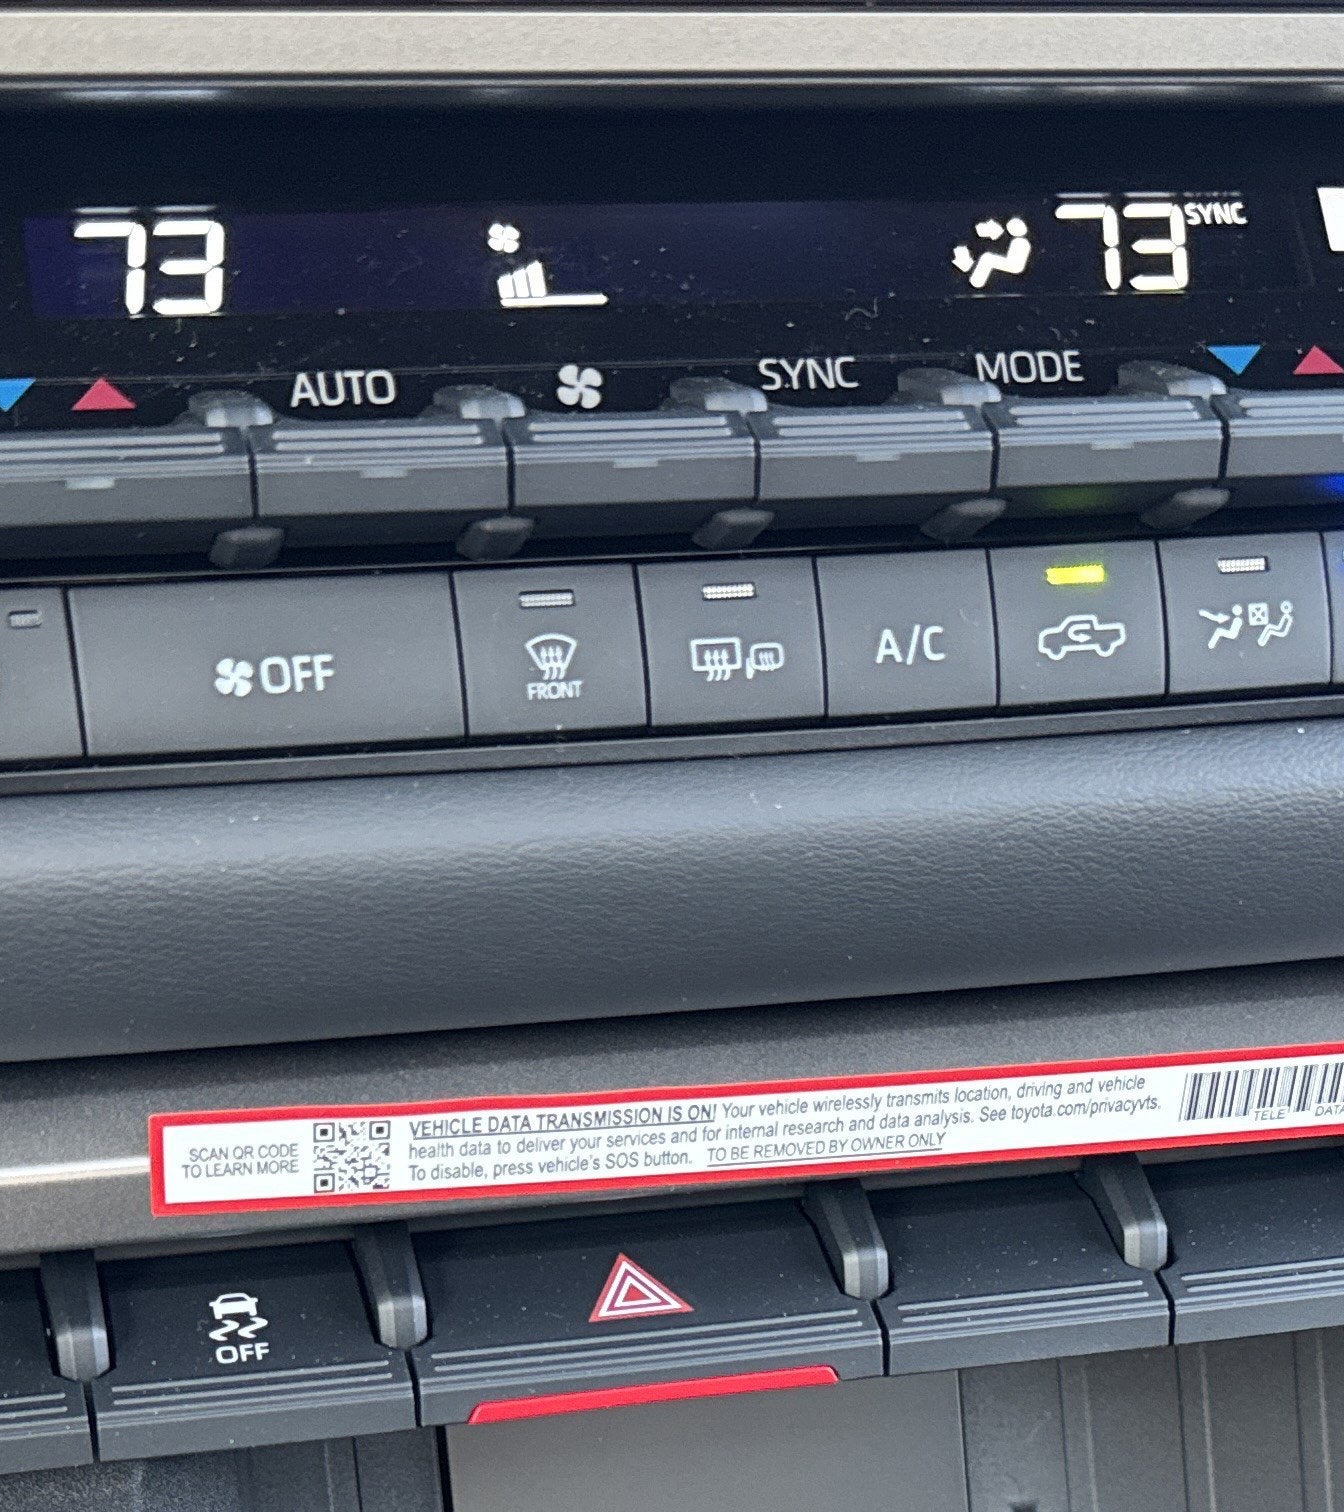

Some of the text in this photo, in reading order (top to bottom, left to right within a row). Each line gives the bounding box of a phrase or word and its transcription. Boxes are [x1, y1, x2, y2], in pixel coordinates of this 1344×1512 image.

[1056, 202, 1248, 292] 73 SYNC
[73, 220, 225, 316] 73
[758, 357, 859, 391] SYNC
[975, 352, 1085, 385] MODE
[290, 370, 397, 408] AUTO
[875, 625, 946, 665] A/C
[259, 654, 336, 695] OFF
[526, 679, 583, 701] FRONT
[409, 1115, 482, 1137] VEHICLE
[487, 1113, 532, 1133] DATA
[536, 1106, 663, 1131] TRANSMISSION
[667, 1105, 683, 1122] IS
[722, 1102, 755, 1119] Your
[759, 1098, 809, 1116] vehicle
[813, 1092, 882, 1113] wirelessly
[886, 1089, 950, 1107] transmits
[954, 1086, 1012, 1103] location,
[1016, 1081, 1063, 1100] driving
[1067, 1077, 1093, 1095] and
[1098, 1074, 1146, 1092] vehicle
[1254, 1107, 1286, 1121] TELE
[408, 1141, 455, 1160] health
[459, 1140, 492, 1157] data
[497, 1139, 512, 1154] to
[516, 1134, 565, 1153] deliver
[569, 1134, 602, 1152] your
[606, 1130, 666, 1148] services
[671, 1125, 698, 1143] and
[702, 1125, 721, 1142] for
[725, 1120, 778, 1140] internal
[782, 1116, 844, 1137] research
[849, 1114, 875, 1133] and
[879, 1112, 910, 1130] data
[914, 1107, 975, 1128] analysis.
[979, 1105, 1007, 1123] See
[182, 1158, 299, 1179] TO LEARN MORE
[189, 1142, 299, 1163] SCAN QR CODE
[408, 1131, 946, 1182] To disable, press vehicle's SOS button. TO BE REMOVED BY OWNER ONLY
[216, 1341, 270, 1366] OFF
